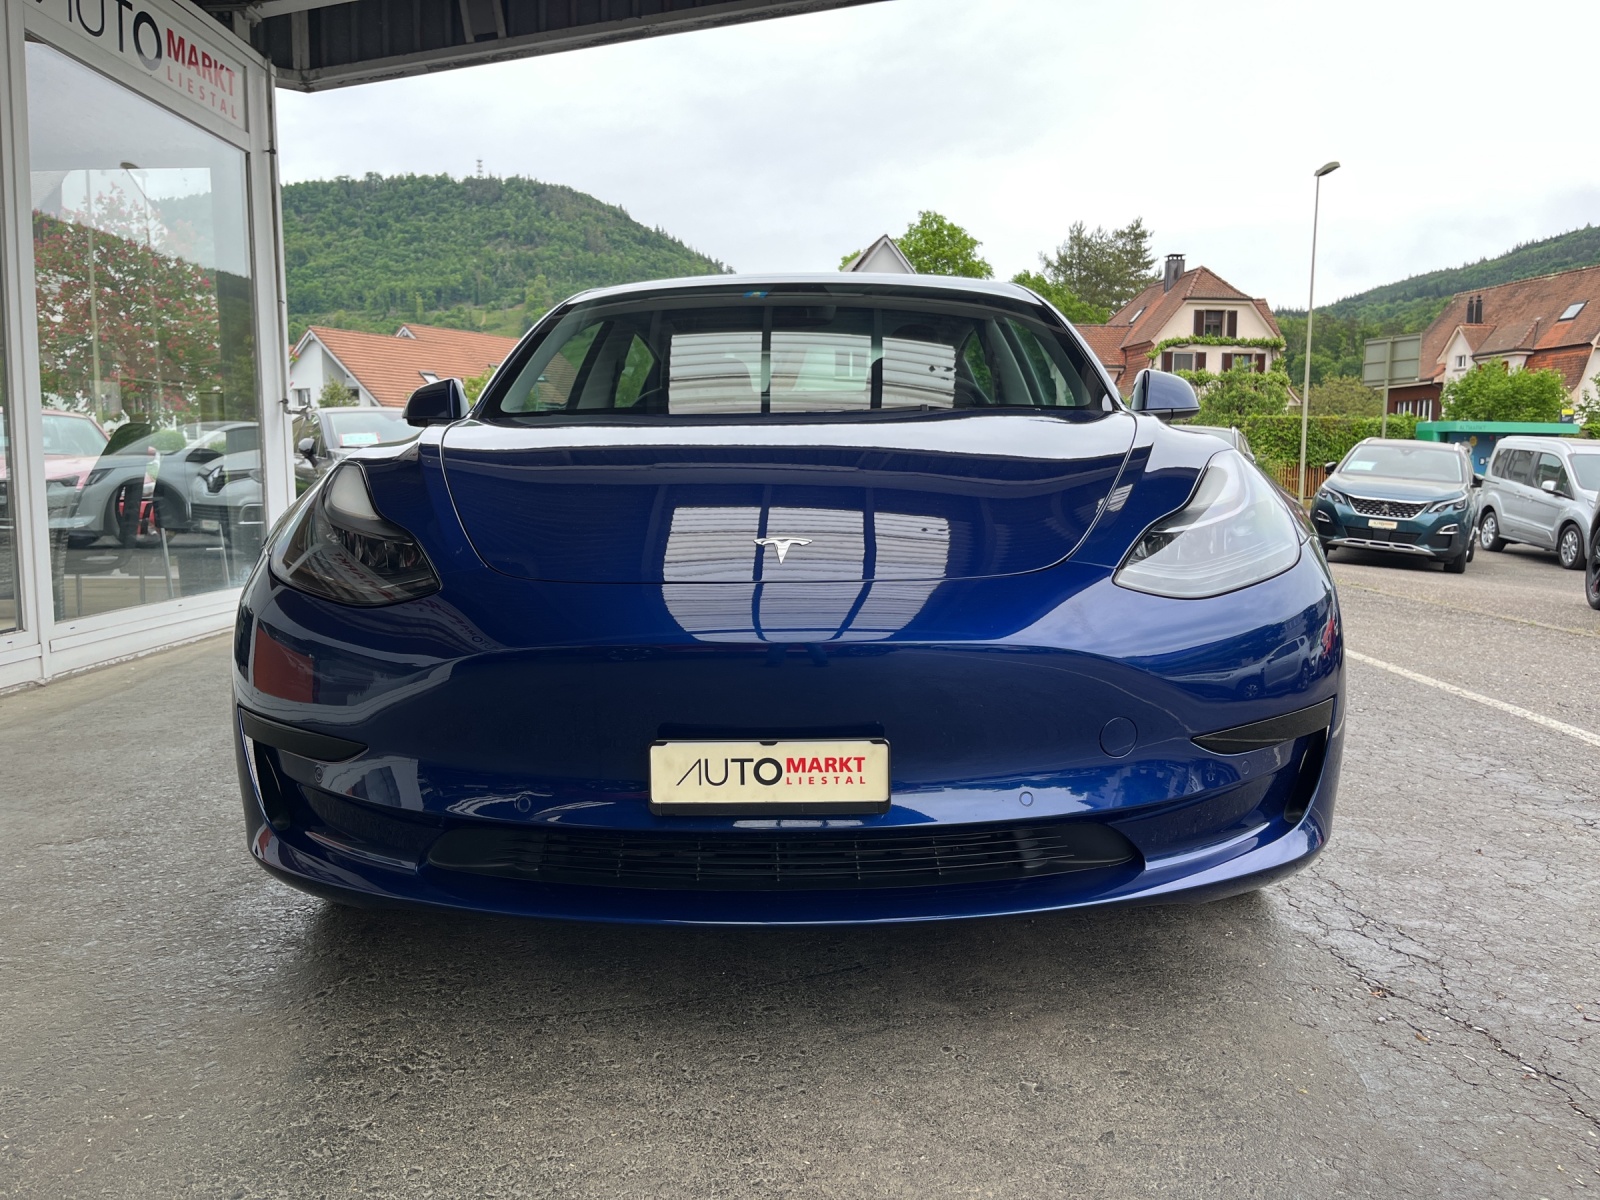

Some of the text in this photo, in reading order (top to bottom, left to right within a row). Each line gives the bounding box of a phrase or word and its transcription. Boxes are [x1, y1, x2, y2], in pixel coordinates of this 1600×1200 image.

[166, 27, 235, 97] MARKT
[166, 65, 237, 120] LIESTAL
[676, 756, 866, 786] AUTO MARKT
[786, 776, 866, 785] LIESTAL
